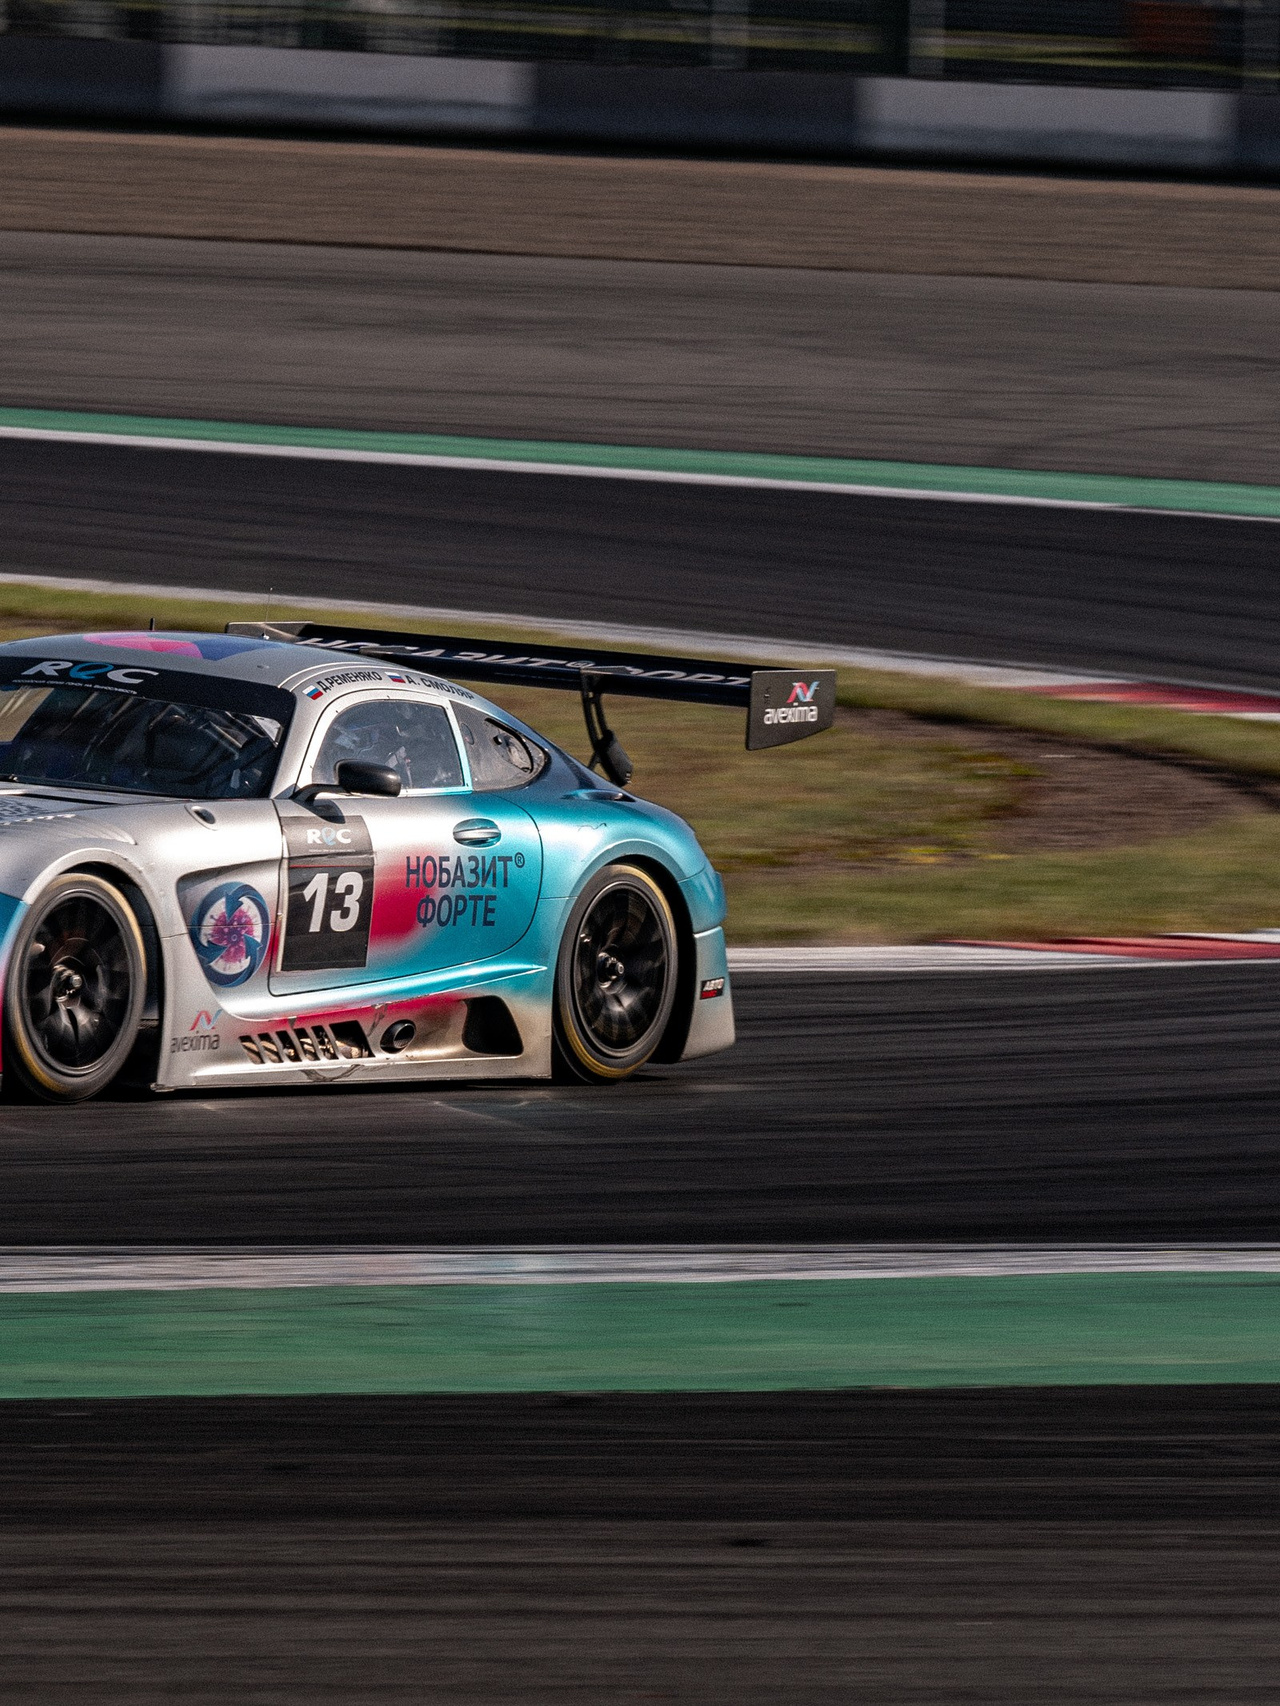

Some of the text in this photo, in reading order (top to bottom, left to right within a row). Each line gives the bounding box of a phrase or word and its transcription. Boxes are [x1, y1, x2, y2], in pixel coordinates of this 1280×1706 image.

[763, 702, 819, 724] avexima
[303, 871, 364, 933] 13
[416, 894, 498, 928] ФОРТЕ
